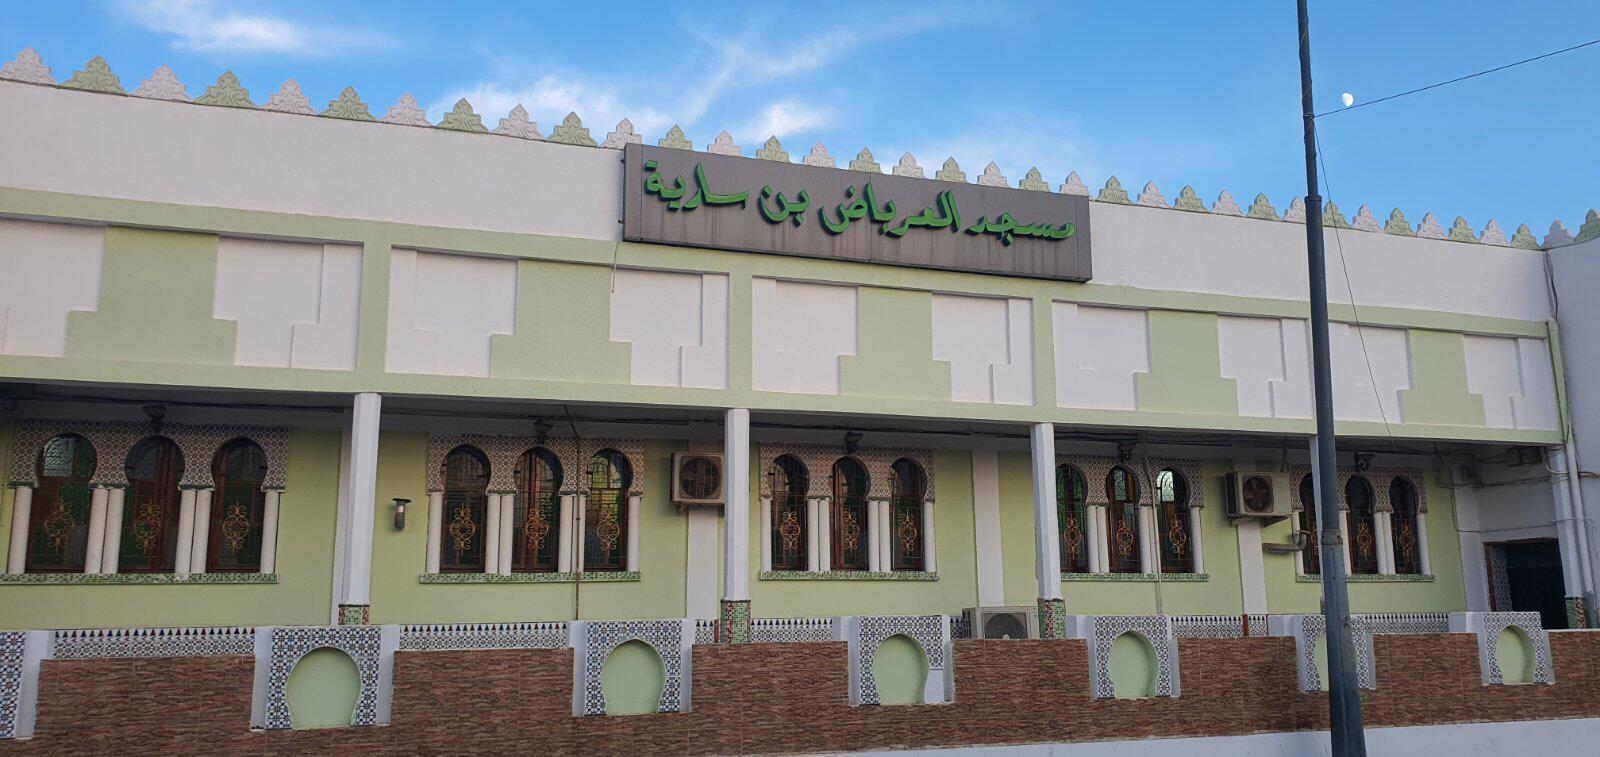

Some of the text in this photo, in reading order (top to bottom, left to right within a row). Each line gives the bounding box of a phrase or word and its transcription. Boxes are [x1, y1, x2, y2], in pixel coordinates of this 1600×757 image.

[643, 159, 1075, 246] مسجد العرباض بن سارية
